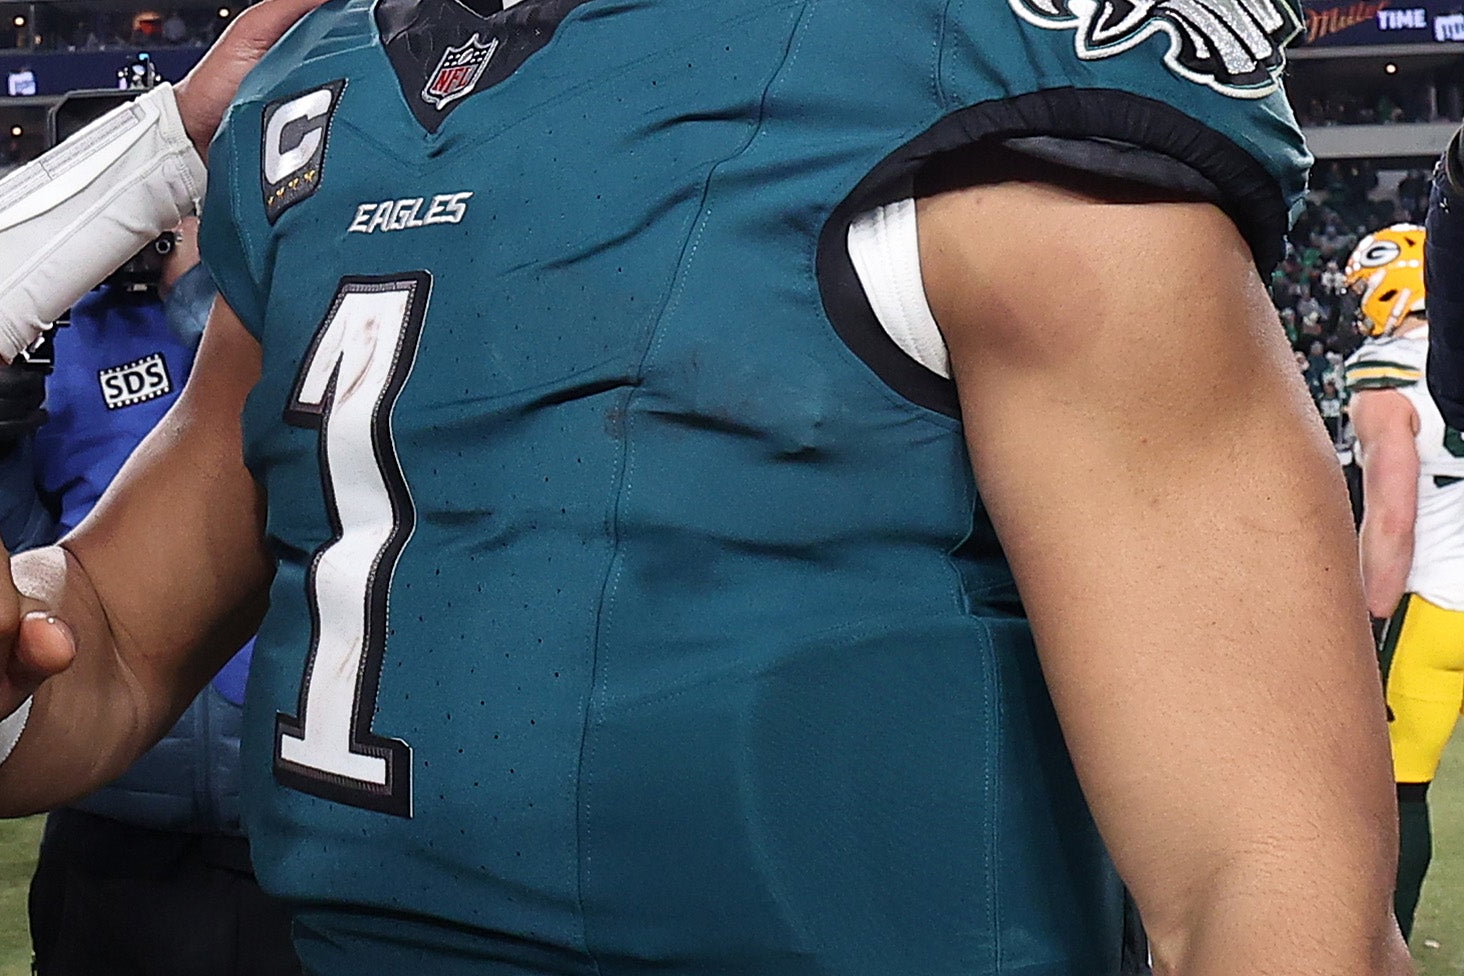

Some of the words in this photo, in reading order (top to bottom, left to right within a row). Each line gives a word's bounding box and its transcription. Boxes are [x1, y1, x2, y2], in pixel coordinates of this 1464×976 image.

[1377, 8, 1427, 30] TIME
[431, 66, 469, 94] NFL
[264, 89, 333, 186] C
[347, 191, 474, 234] EAGLES
[105, 362, 164, 399] SDS
[274, 270, 432, 818] 1
